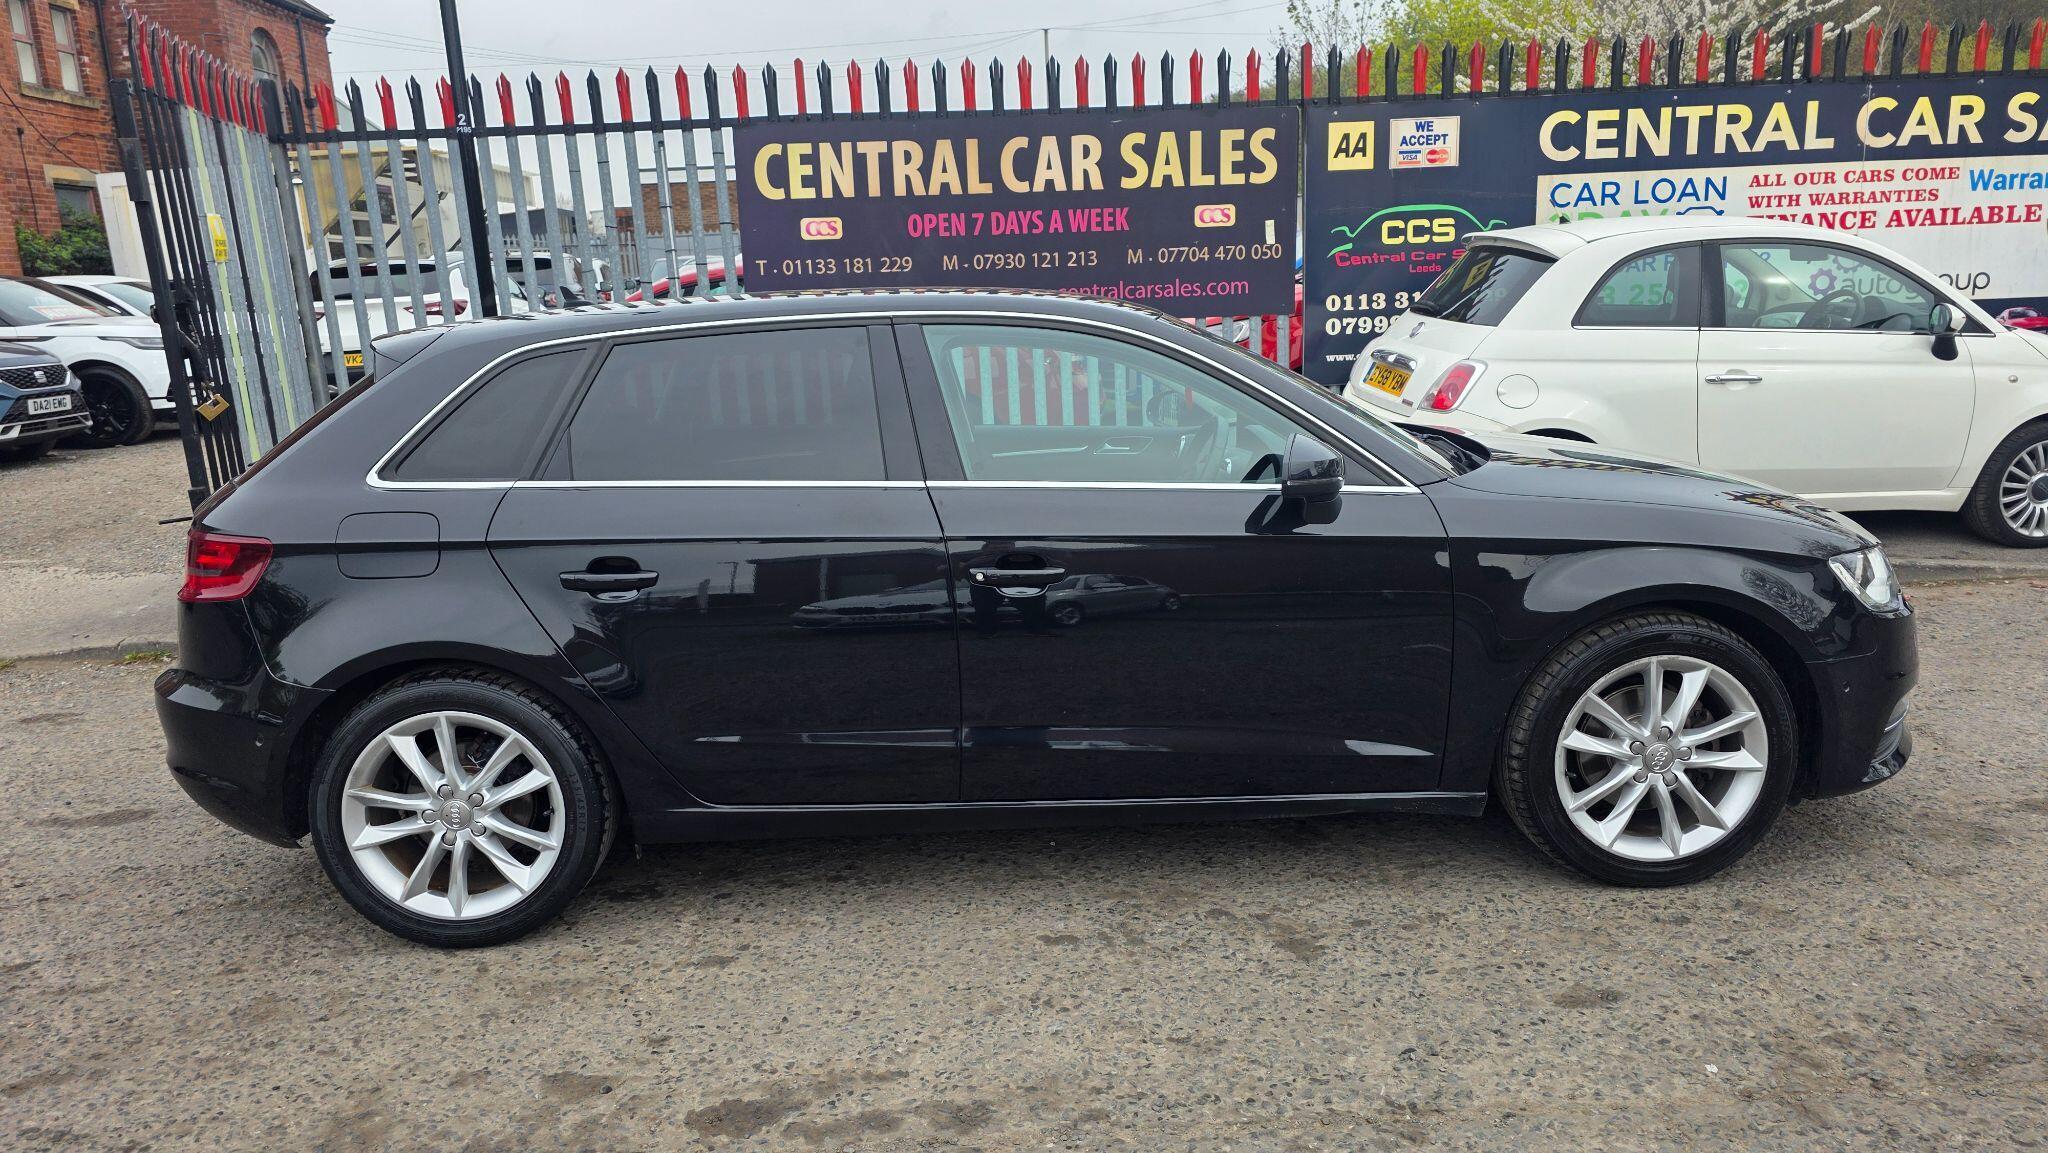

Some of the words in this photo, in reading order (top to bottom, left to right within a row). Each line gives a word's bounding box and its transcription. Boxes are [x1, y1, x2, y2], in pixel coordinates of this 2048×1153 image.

[457, 113, 467, 126] 2
[1415, 121, 1434, 133] WE
[1539, 100, 1837, 162] CENTRAL
[1856, 94, 1986, 149] CAR
[1333, 132, 1367, 158] AA
[1400, 134, 1449, 147] ACCEPT
[753, 138, 993, 201] CENTRAL
[999, 134, 1104, 193] CAR
[1119, 127, 1279, 189] SALES
[1748, 173, 1787, 188] ALL
[1794, 171, 1837, 186] OUR
[1840, 169, 1896, 184] CARS
[1902, 166, 1961, 182] COME
[1968, 167, 2048, 192] Warra
[1549, 181, 1621, 209] CAR
[1634, 176, 1727, 205] LOAN
[1747, 194, 1802, 209] WITH
[1809, 188, 1941, 206] WARRANTIES
[907, 212, 966, 238] OPEN
[970, 212, 985, 237] 7
[990, 209, 1044, 235] DAYS
[1048, 210, 1064, 233] A
[1067, 207, 1130, 232] WEEK
[1747, 209, 1877, 231] ANCE
[1885, 203, 2043, 228] AVAILABLE
[1381, 218, 1455, 245] CCS
[943, 255, 959, 270] M
[973, 253, 1026, 270] 07930
[1032, 251, 1060, 268] 121
[1067, 250, 1098, 268] 213
[1127, 248, 1143, 264] M
[1158, 246, 1209, 264] 07704
[1214, 244, 1246, 262] 470
[1251, 243, 1283, 259] 050
[1335, 251, 1406, 267] Central
[1411, 249, 1446, 261] Car
[756, 260, 768, 275] T
[782, 258, 837, 275] 01133
[844, 257, 872, 273] 181
[880, 256, 913, 273] 229
[1409, 263, 1442, 274] Leeds
[1325, 292, 1387, 312] 0113
[33, 398, 51, 412] DA21
[52, 397, 68, 410] EWG
